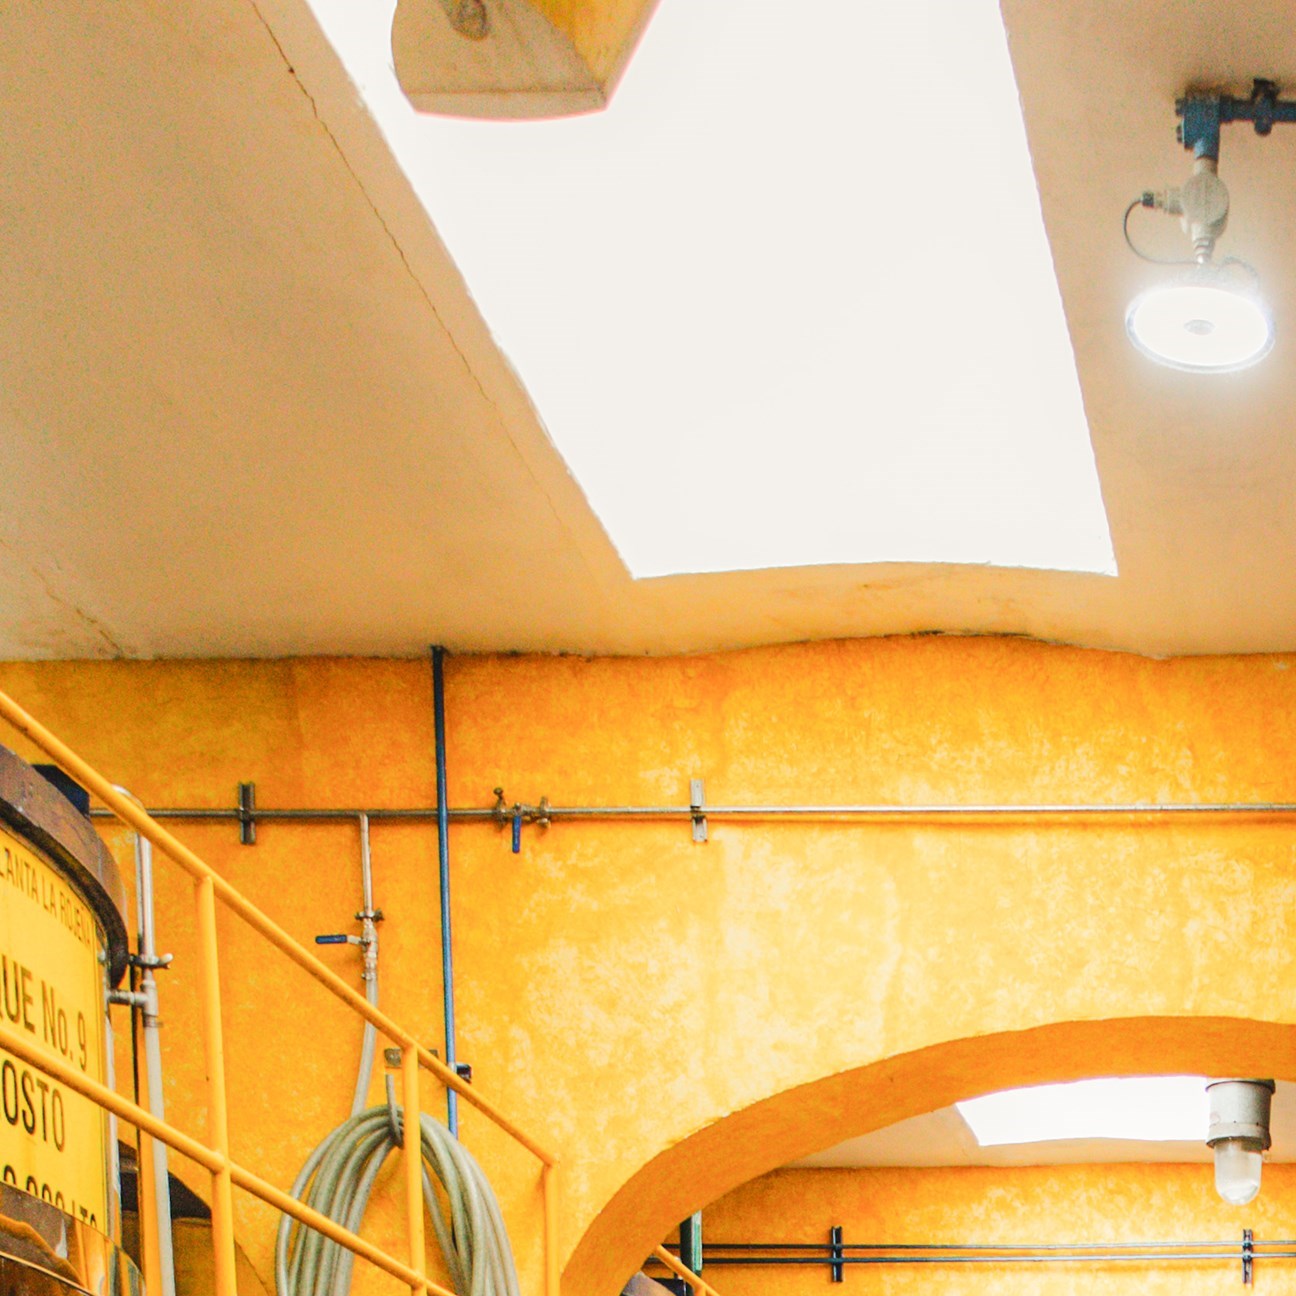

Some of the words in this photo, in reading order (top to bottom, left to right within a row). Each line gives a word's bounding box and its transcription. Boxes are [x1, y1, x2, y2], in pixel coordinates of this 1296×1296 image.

[42, 875, 58, 919] LA
[41, 980, 74, 1062] No.
[77, 1010, 88, 1072] 9
